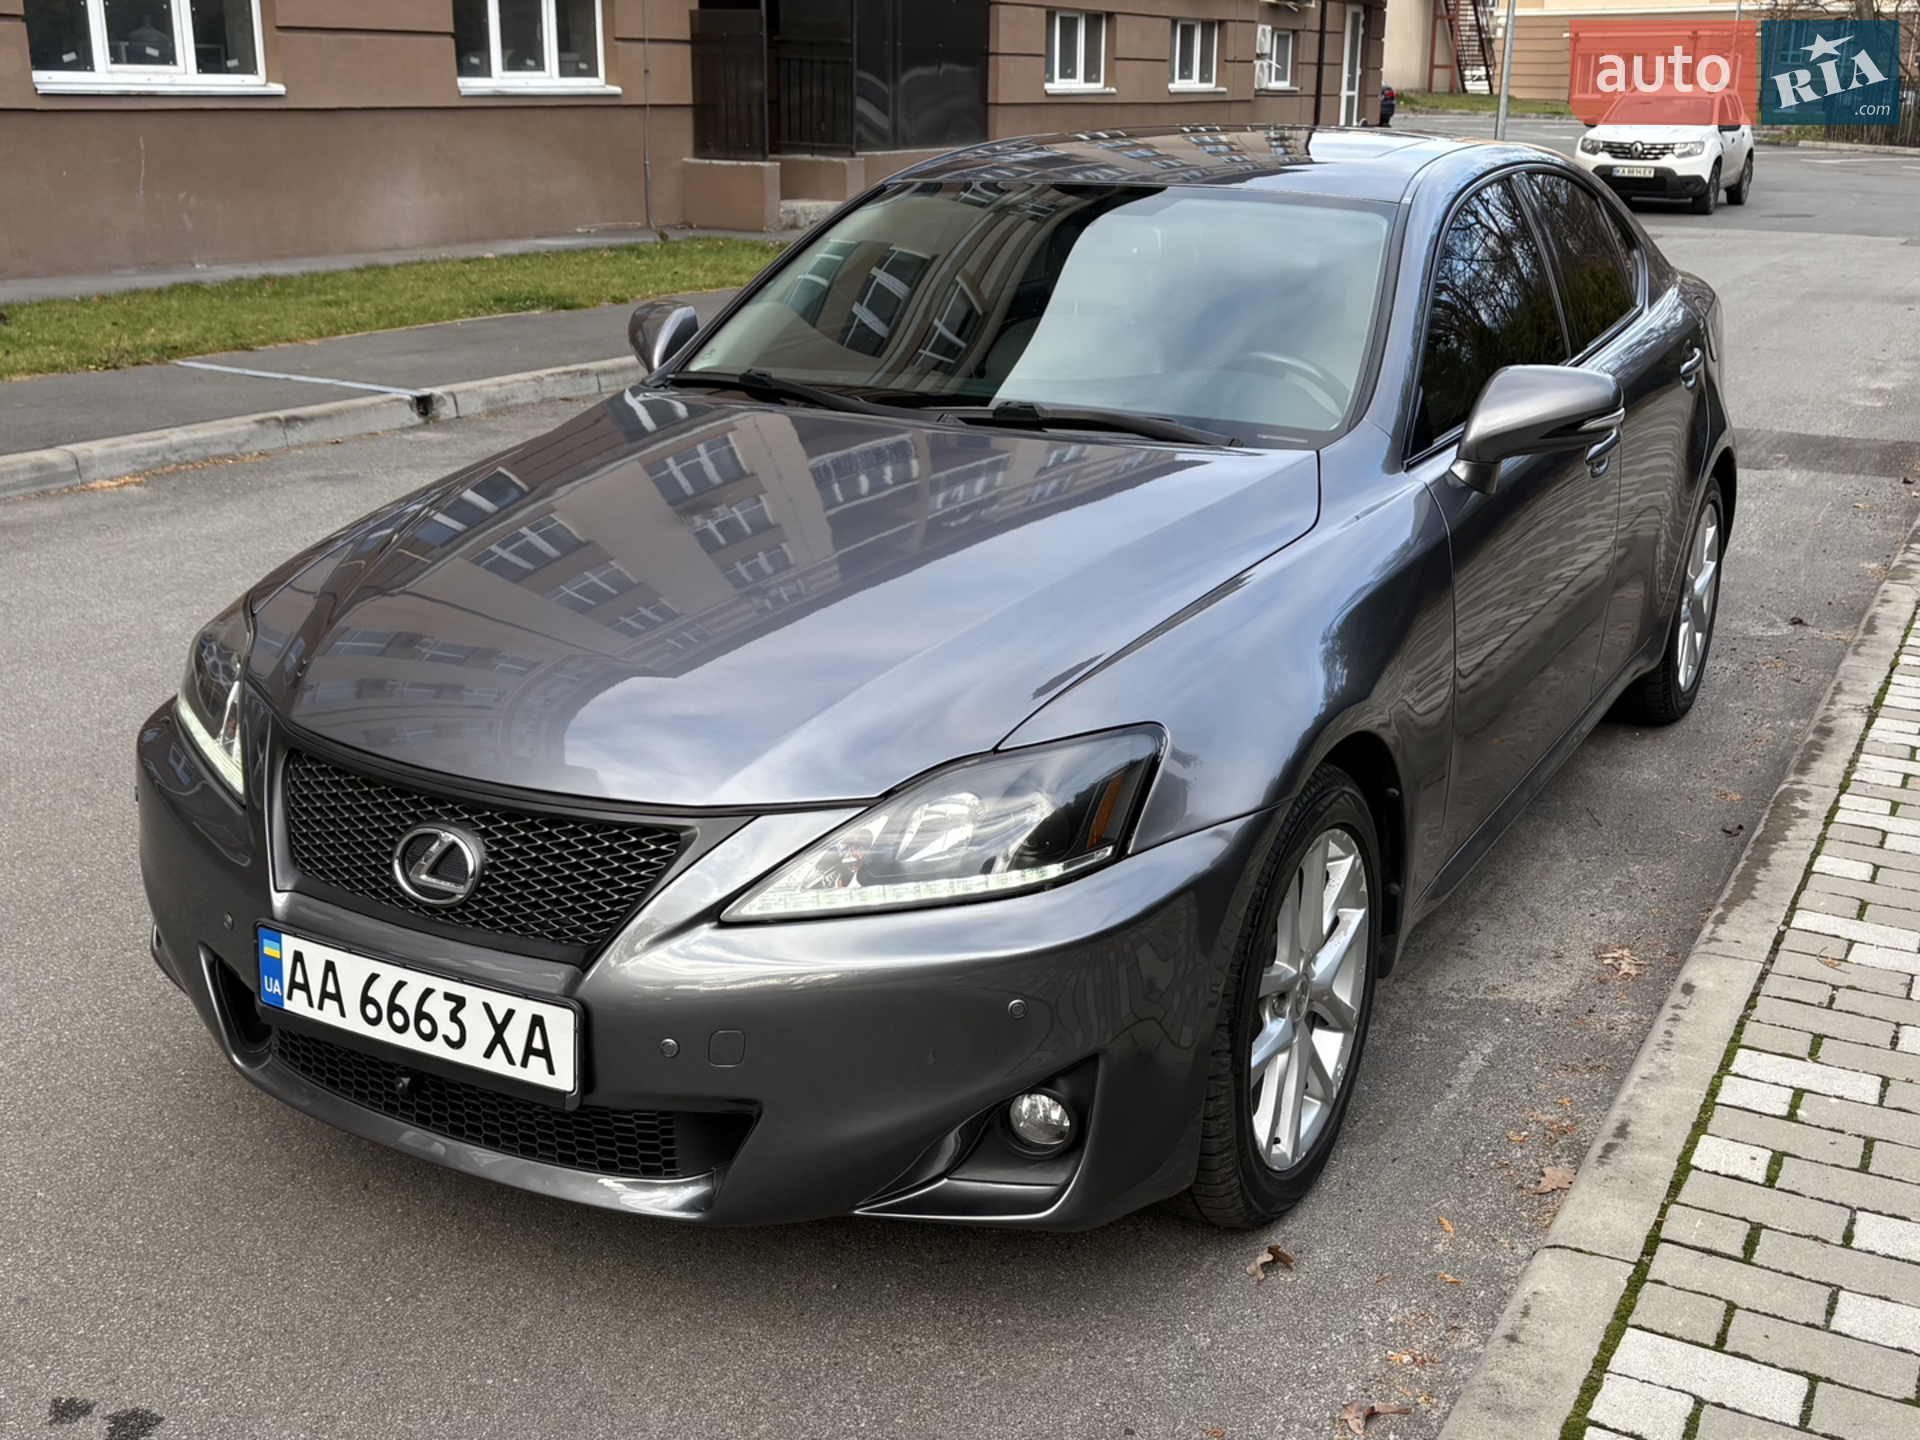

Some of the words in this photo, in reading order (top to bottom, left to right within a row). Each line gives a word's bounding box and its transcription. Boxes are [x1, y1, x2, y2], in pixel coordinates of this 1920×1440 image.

[264, 975, 282, 996] UA
[286, 949, 346, 1018] AA
[359, 972, 467, 1049] 6663
[482, 1001, 556, 1075] XA
